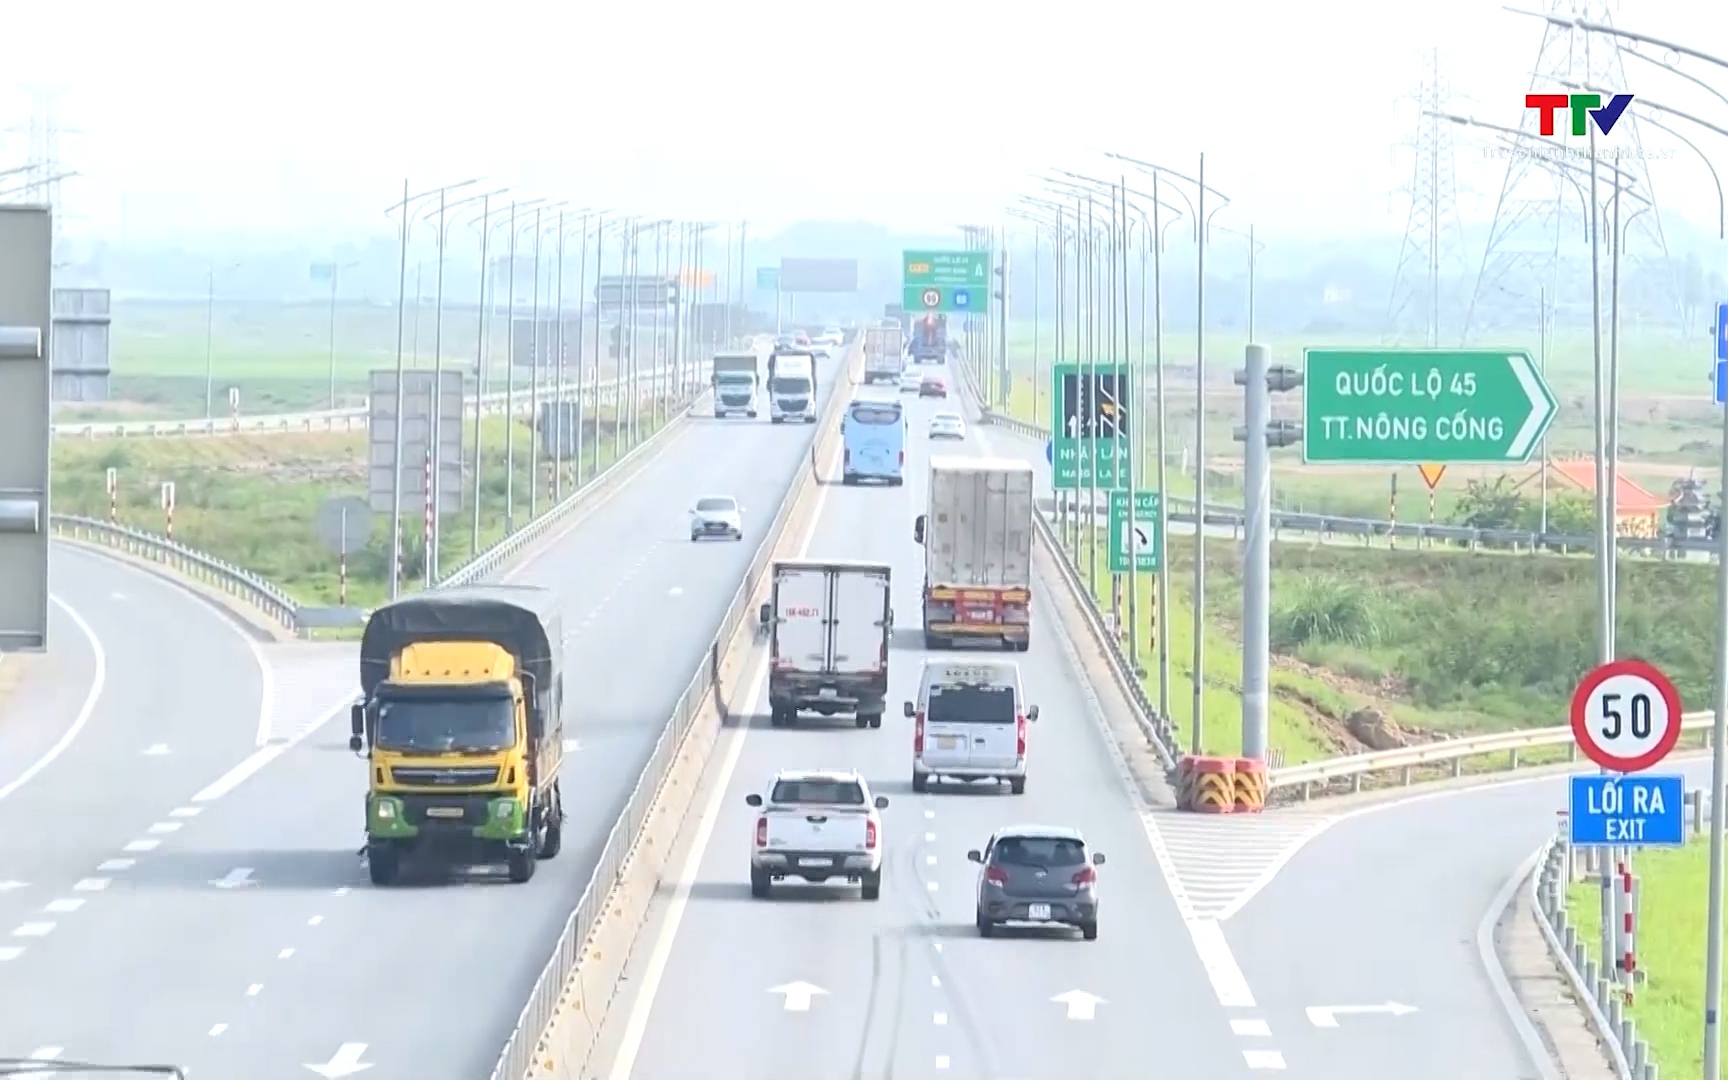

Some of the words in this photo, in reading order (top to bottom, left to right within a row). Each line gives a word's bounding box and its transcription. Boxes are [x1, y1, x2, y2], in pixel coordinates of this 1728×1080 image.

[1336, 363, 1404, 396] QUỐC
[1411, 368, 1442, 400] LỘ
[1450, 372, 1476, 396] 45
[1435, 408, 1504, 440] CỐNG
[1601, 693, 1652, 740] 50
[1588, 775, 1623, 814] LỐI
[1633, 785, 1666, 814] RA
[1605, 818, 1647, 840] EXIT
